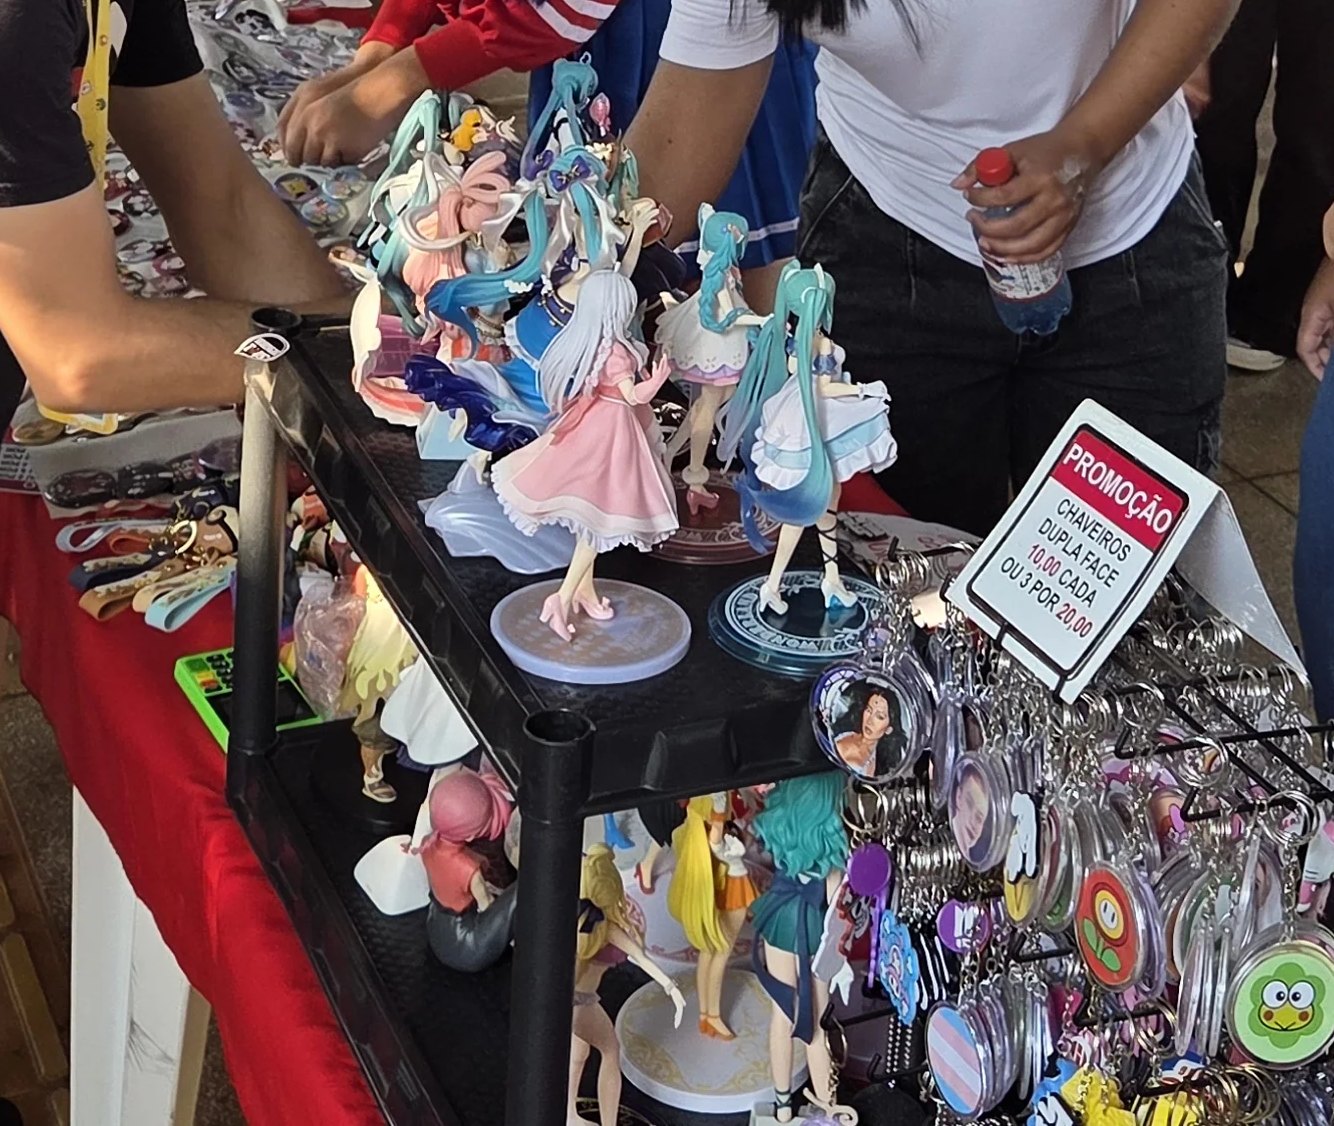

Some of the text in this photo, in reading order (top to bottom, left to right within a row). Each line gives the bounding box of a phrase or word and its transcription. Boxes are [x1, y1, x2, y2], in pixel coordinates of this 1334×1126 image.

[1063, 443, 1172, 534] PROMOÇÃO
[1038, 517, 1120, 588] DUPLA FACE
[1057, 499, 1131, 562] CHAVEIROS
[1000, 556, 1094, 638] OU 3 POR 20,00
[1027, 543, 1098, 609] 10,00 CADA
